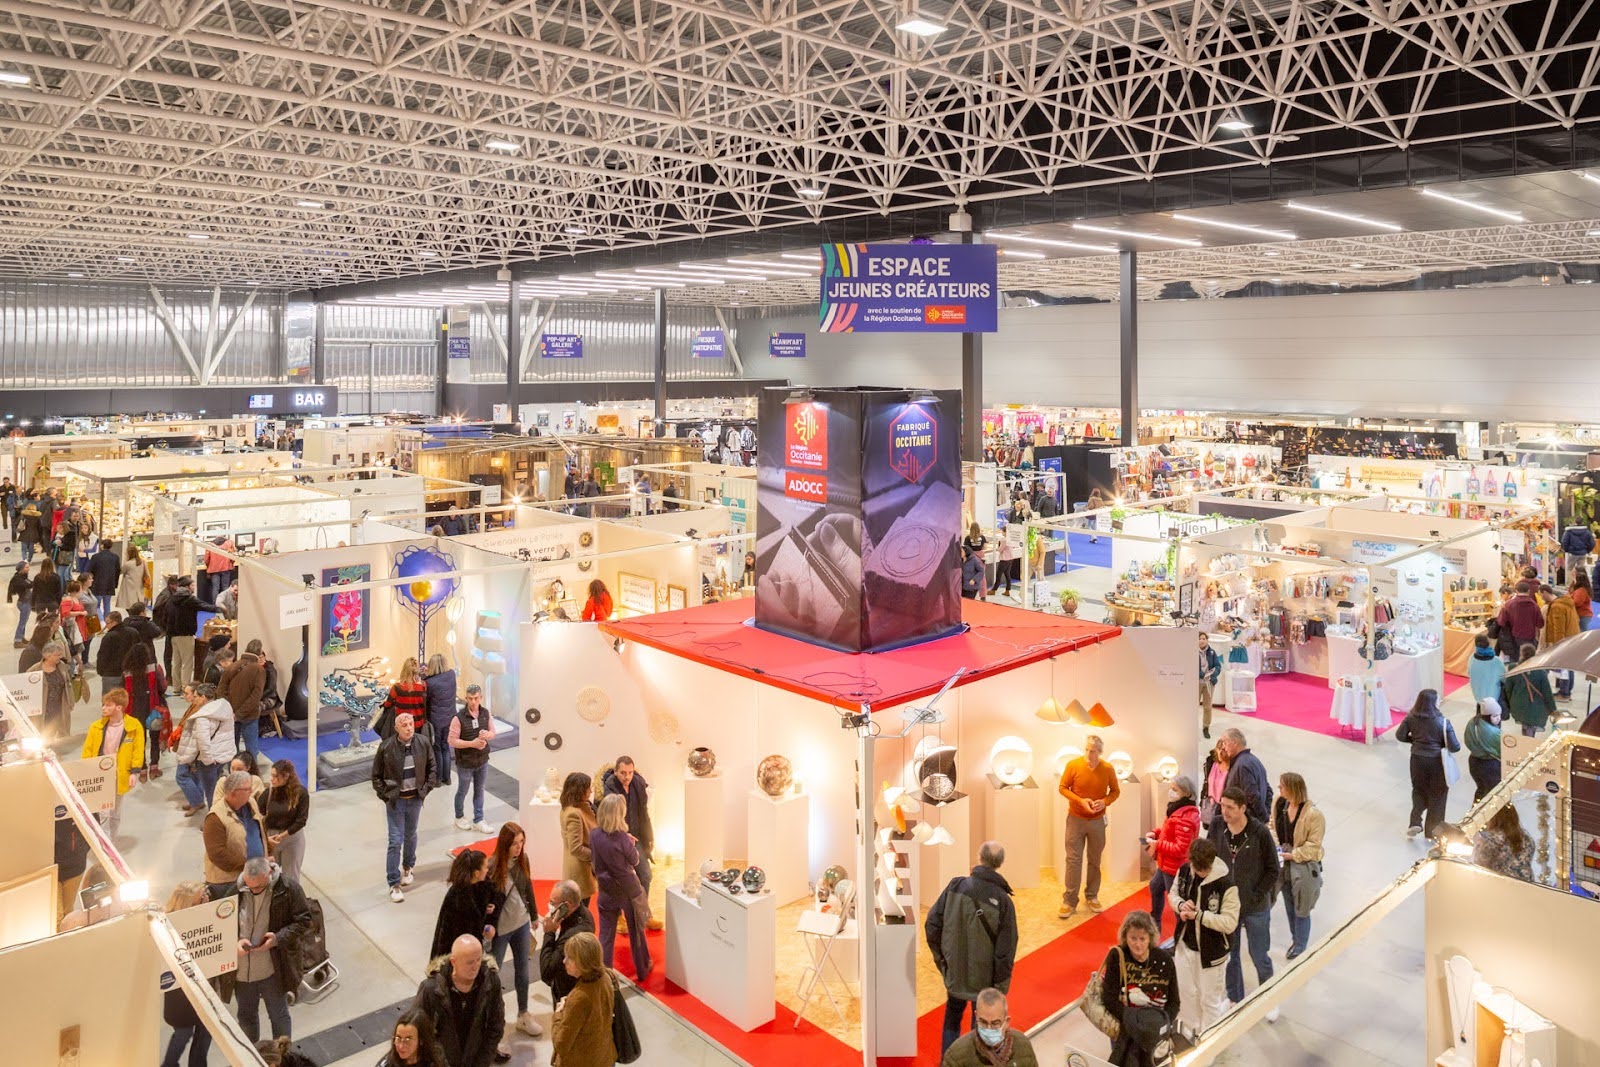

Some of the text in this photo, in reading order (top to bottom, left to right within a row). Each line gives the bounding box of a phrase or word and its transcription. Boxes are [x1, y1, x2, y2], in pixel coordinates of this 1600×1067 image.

[868, 257, 951, 277] ESPACE
[828, 279, 990, 298] JEUNES CRÉATEURS
[870, 315, 892, 323] Région
[295, 393, 325, 406] BAR
[896, 421, 930, 431] FABRIQUÉ
[895, 434, 932, 448] OCCITANIE
[790, 450, 823, 462] Occitanie
[534, 546, 556, 554] verre
[76, 776, 104, 788] ATELIER
[77, 785, 103, 795] SAÏQUE
[181, 924, 214, 941] SOPHIE
[189, 944, 224, 961] AMIQUE
[220, 961, 236, 972] B14
